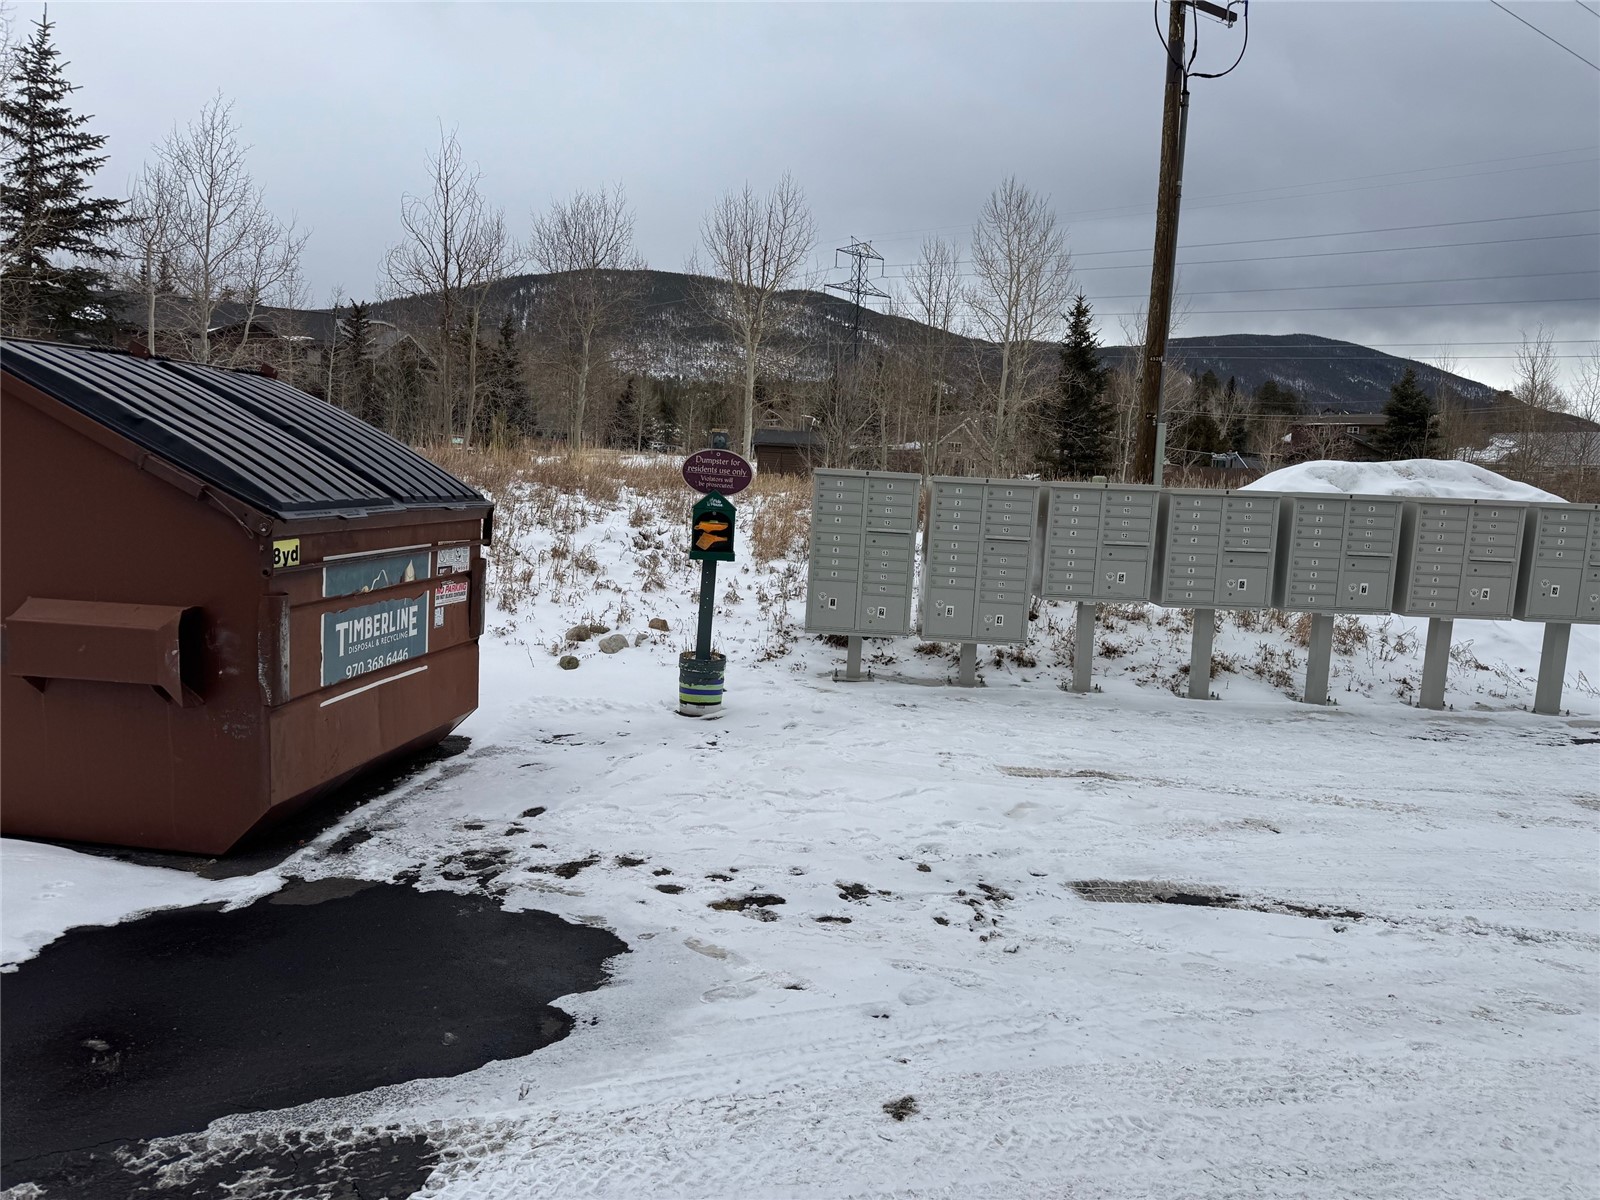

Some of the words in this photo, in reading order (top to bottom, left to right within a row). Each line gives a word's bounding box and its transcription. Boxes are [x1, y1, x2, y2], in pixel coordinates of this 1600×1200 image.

[688, 465, 717, 473] residents
[732, 468, 747, 477] only
[695, 455, 729, 466] Dumpster
[274, 545, 298, 566] 8yd
[445, 583, 467, 593] PARKING
[336, 605, 418, 657] TIMBERLINE
[348, 641, 374, 654] DISPOSAL
[381, 631, 408, 644] RECYCLING
[346, 648, 408, 679] 970.368.6446
